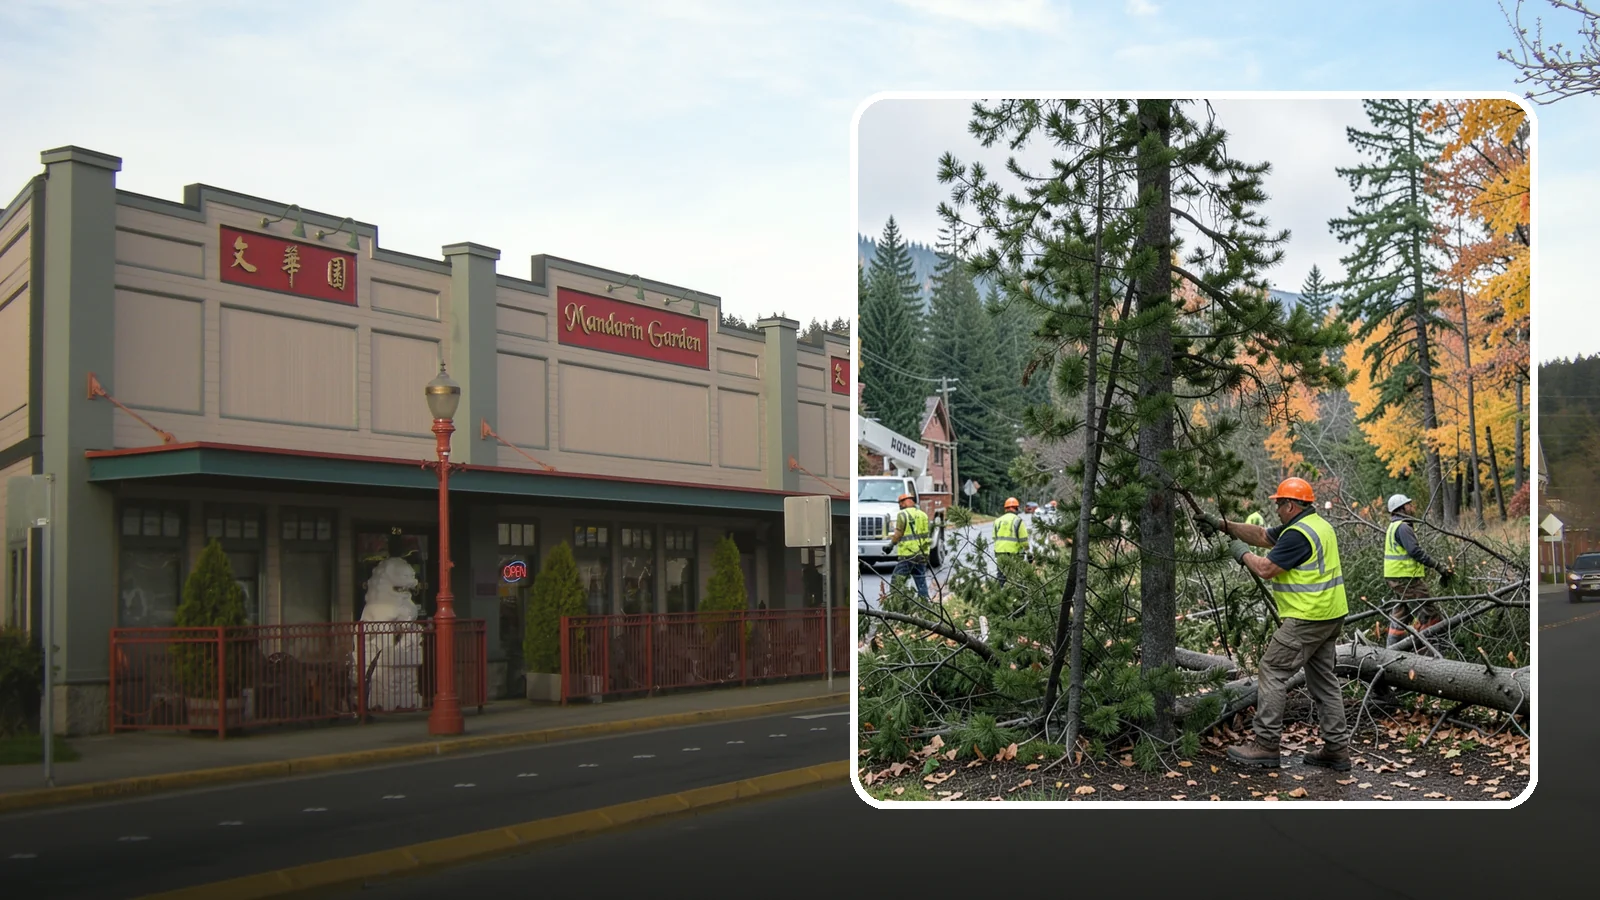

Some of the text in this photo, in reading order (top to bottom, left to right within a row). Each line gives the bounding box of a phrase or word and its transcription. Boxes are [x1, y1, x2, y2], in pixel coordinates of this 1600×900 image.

[230, 235, 347, 291] 文華園
[564, 302, 702, 352] Mandarin Garden
[503, 565, 527, 578] OPEN
